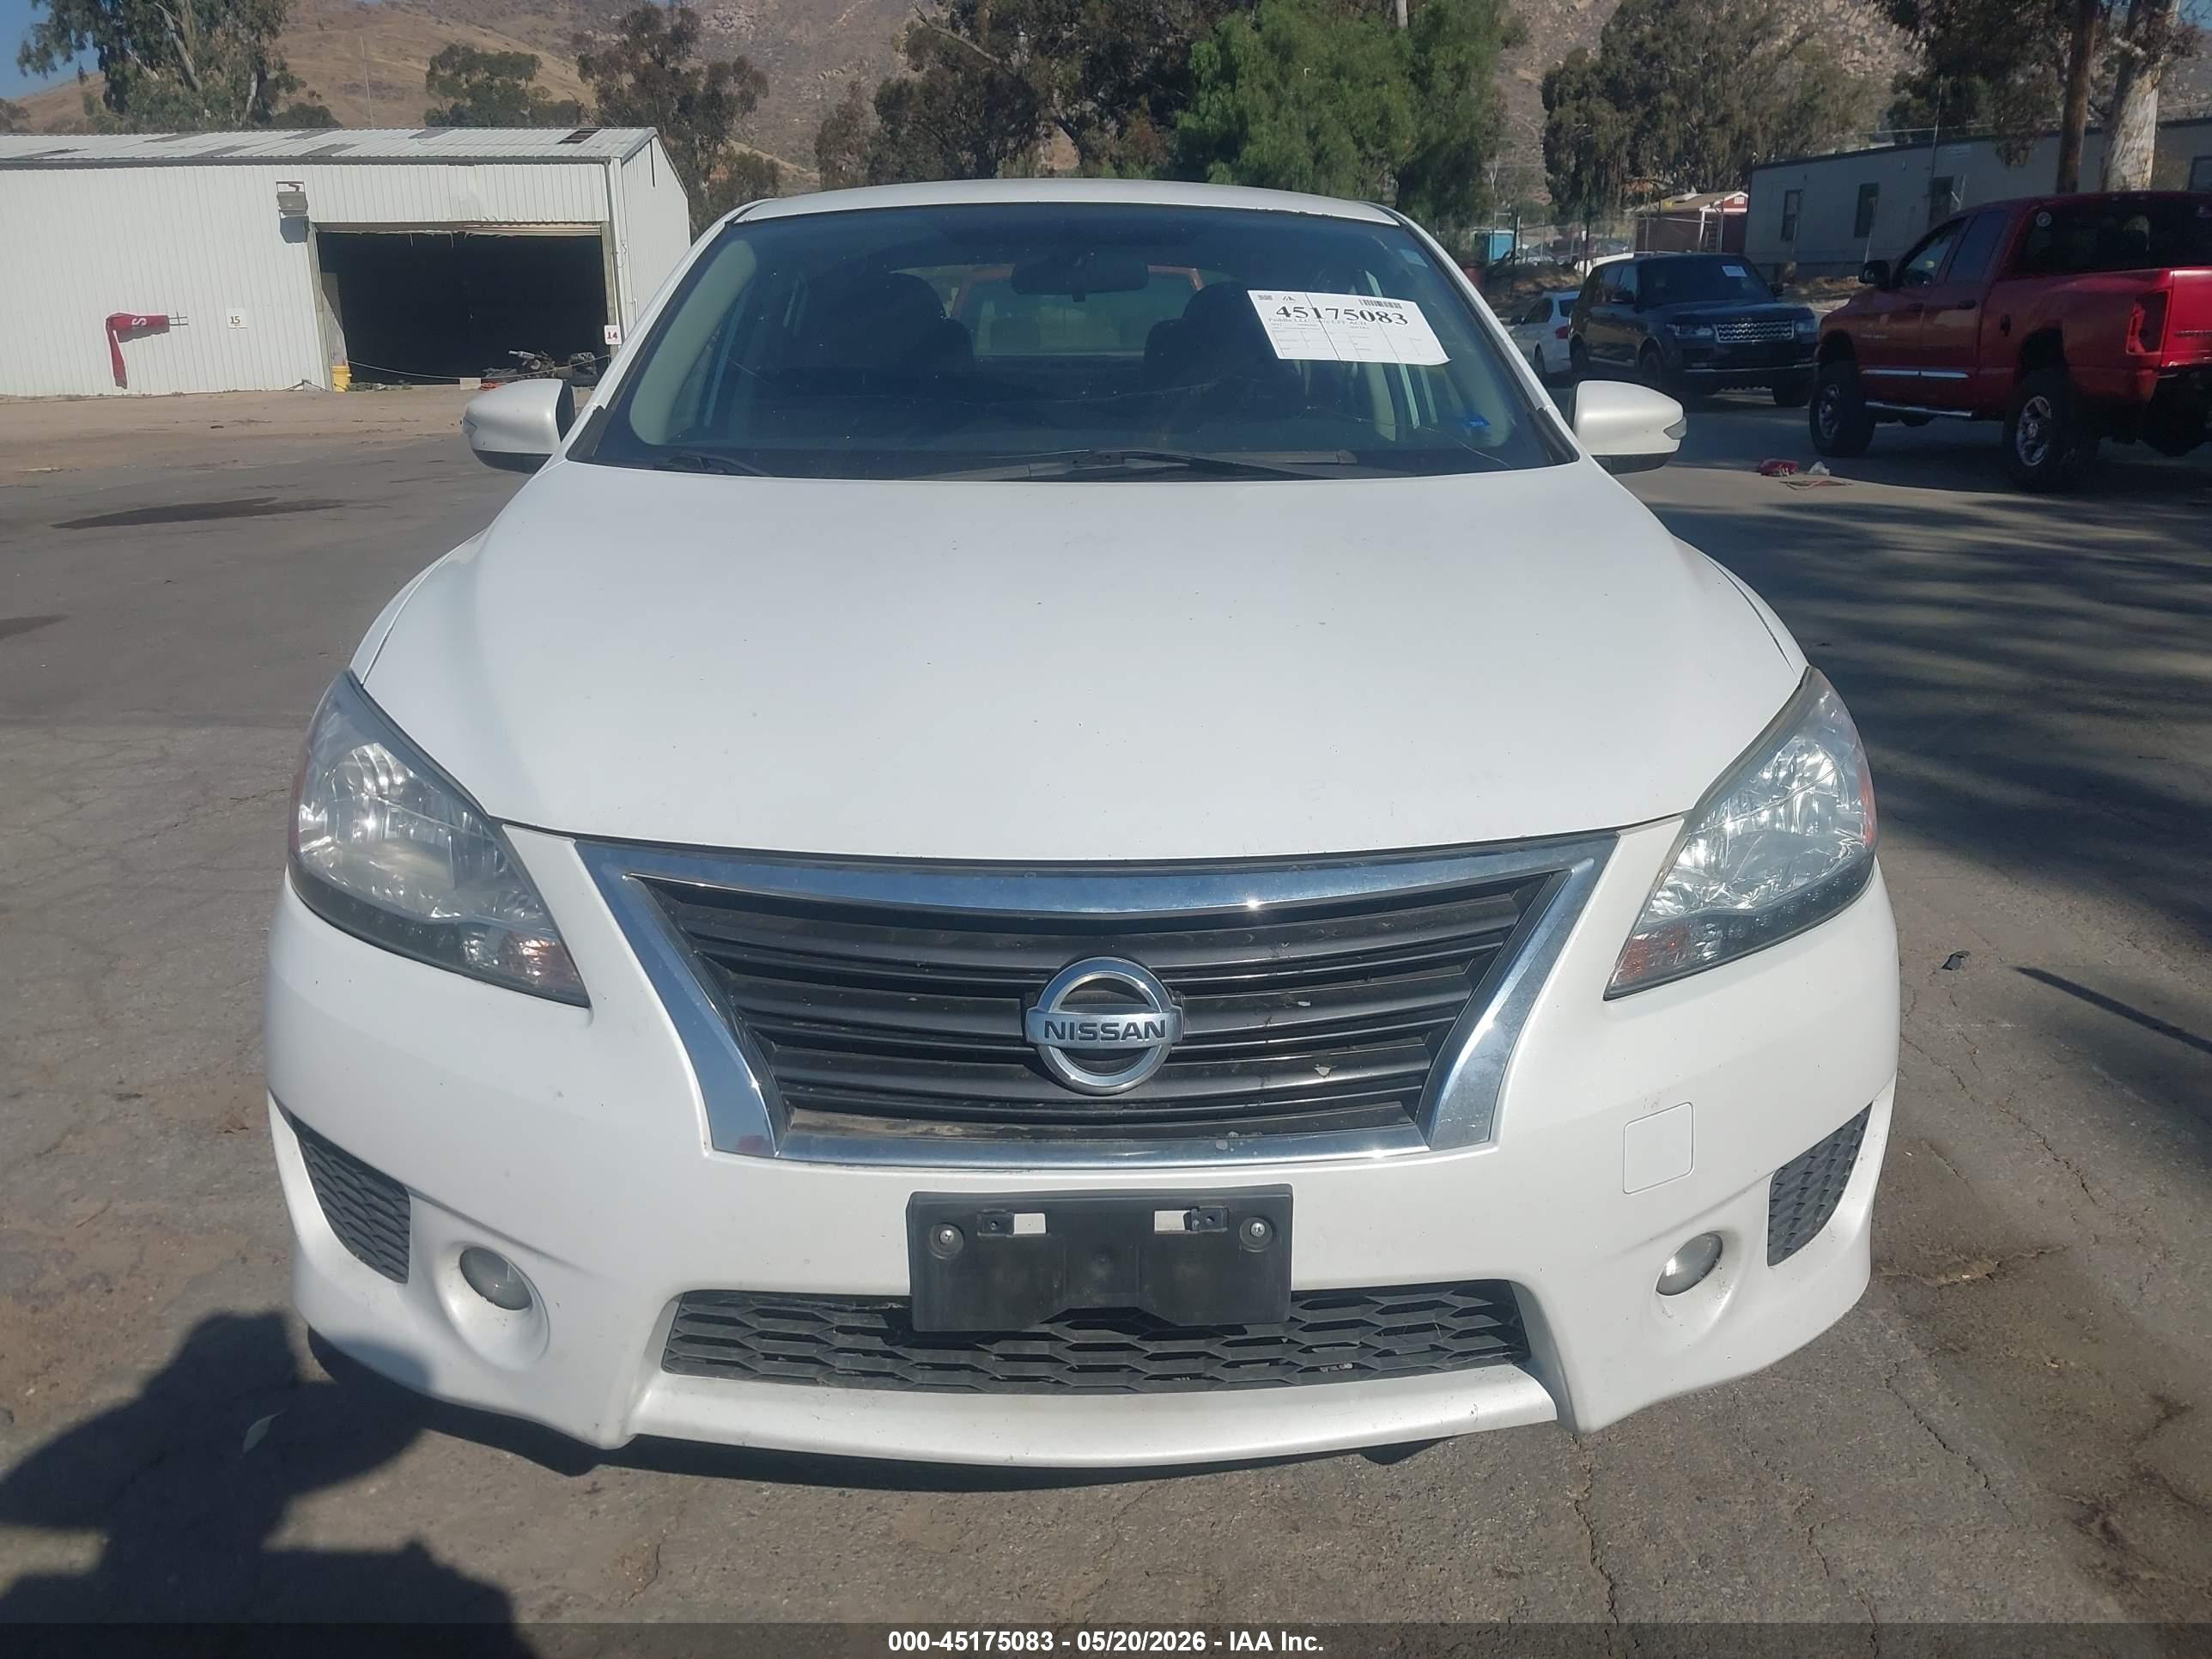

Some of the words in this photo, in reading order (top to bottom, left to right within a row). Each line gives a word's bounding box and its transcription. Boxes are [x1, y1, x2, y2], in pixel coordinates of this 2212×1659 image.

[230, 315, 240, 325] 15
[1276, 306, 1408, 325] 45175083
[1044, 1019, 1166, 1042] NISSAN
